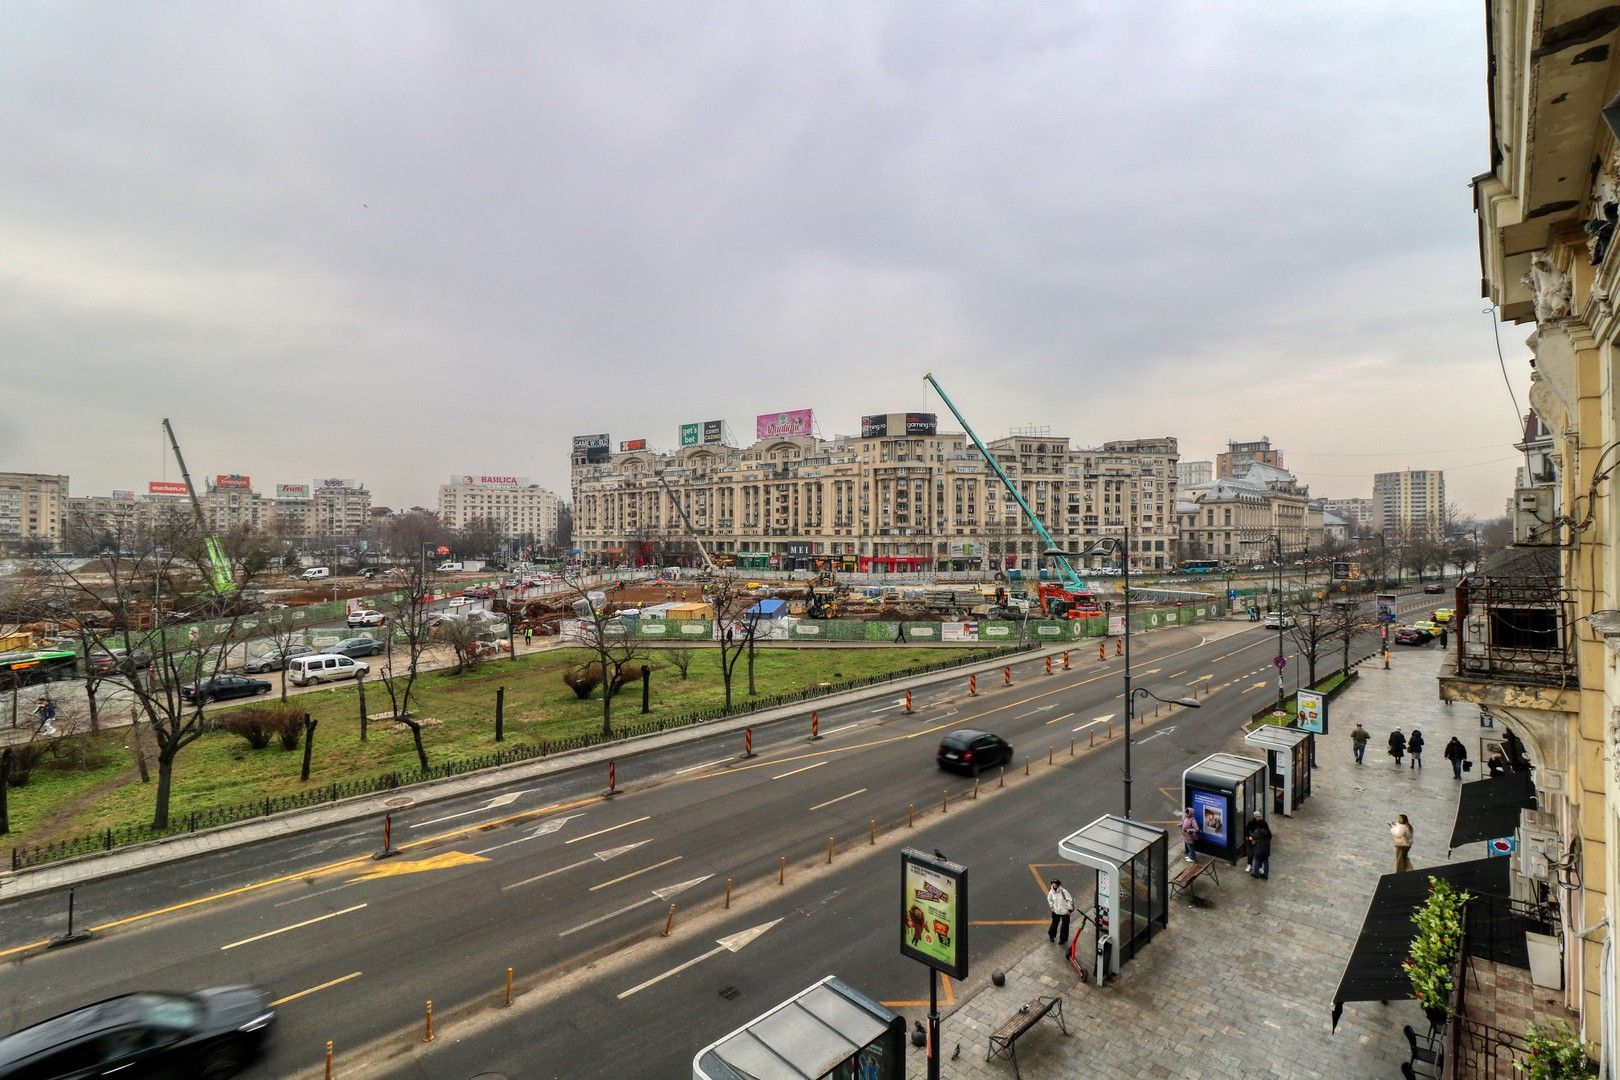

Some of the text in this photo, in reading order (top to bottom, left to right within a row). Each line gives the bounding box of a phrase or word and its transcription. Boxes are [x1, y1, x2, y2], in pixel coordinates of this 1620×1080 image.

[682, 426, 698, 436] get's
[684, 436, 696, 444] bet
[481, 476, 517, 485] BASILICA
